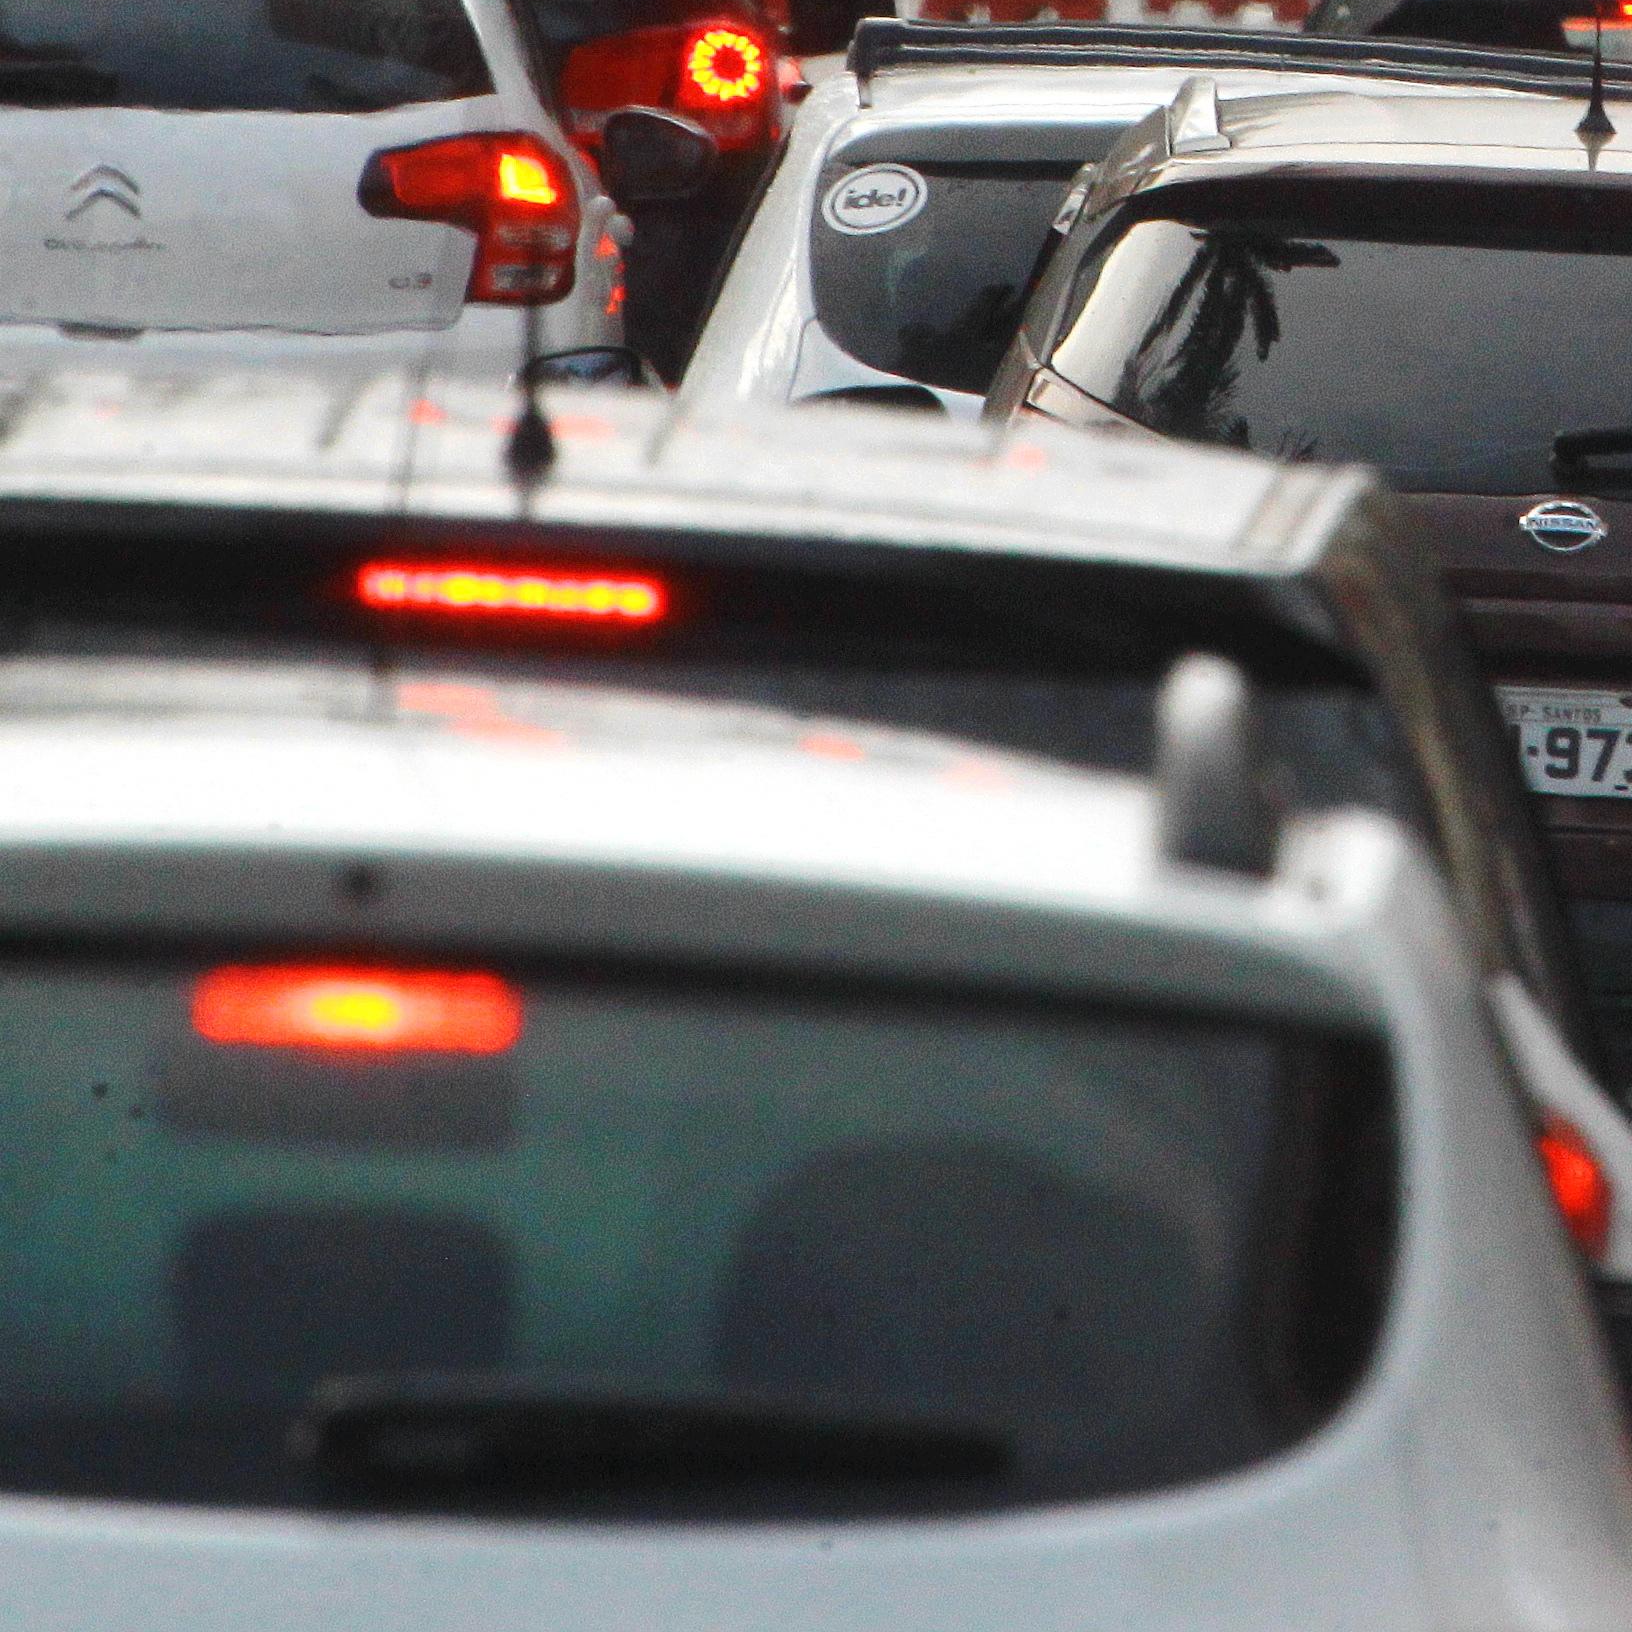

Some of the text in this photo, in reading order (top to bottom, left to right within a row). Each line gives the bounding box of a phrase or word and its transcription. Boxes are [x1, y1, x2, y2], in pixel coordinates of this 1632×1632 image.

[843, 188, 907, 209] ide!
[1527, 516, 1599, 531] NISSAN
[1542, 704, 1601, 724] SANTOS
